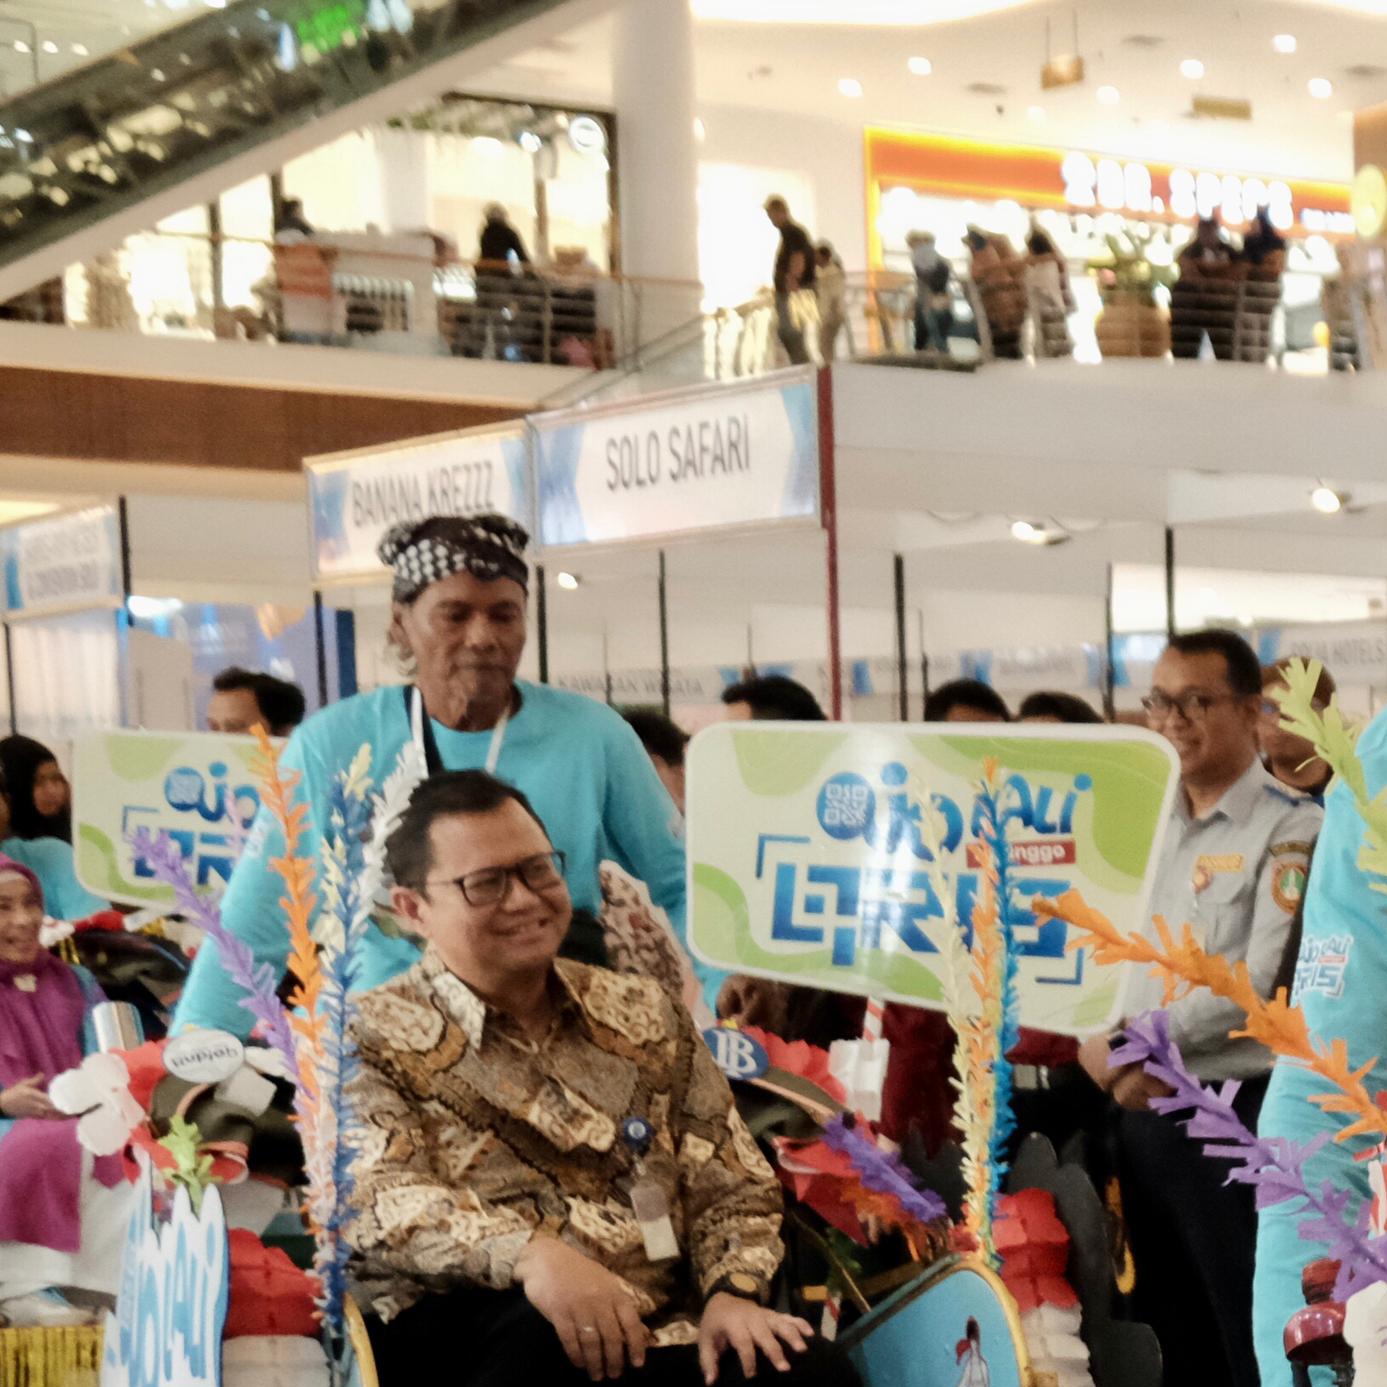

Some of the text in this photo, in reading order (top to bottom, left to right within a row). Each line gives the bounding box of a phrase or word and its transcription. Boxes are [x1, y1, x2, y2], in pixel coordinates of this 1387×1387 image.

[606, 412, 751, 491] SOLO SAFARI
[352, 471, 422, 528] BANANA
